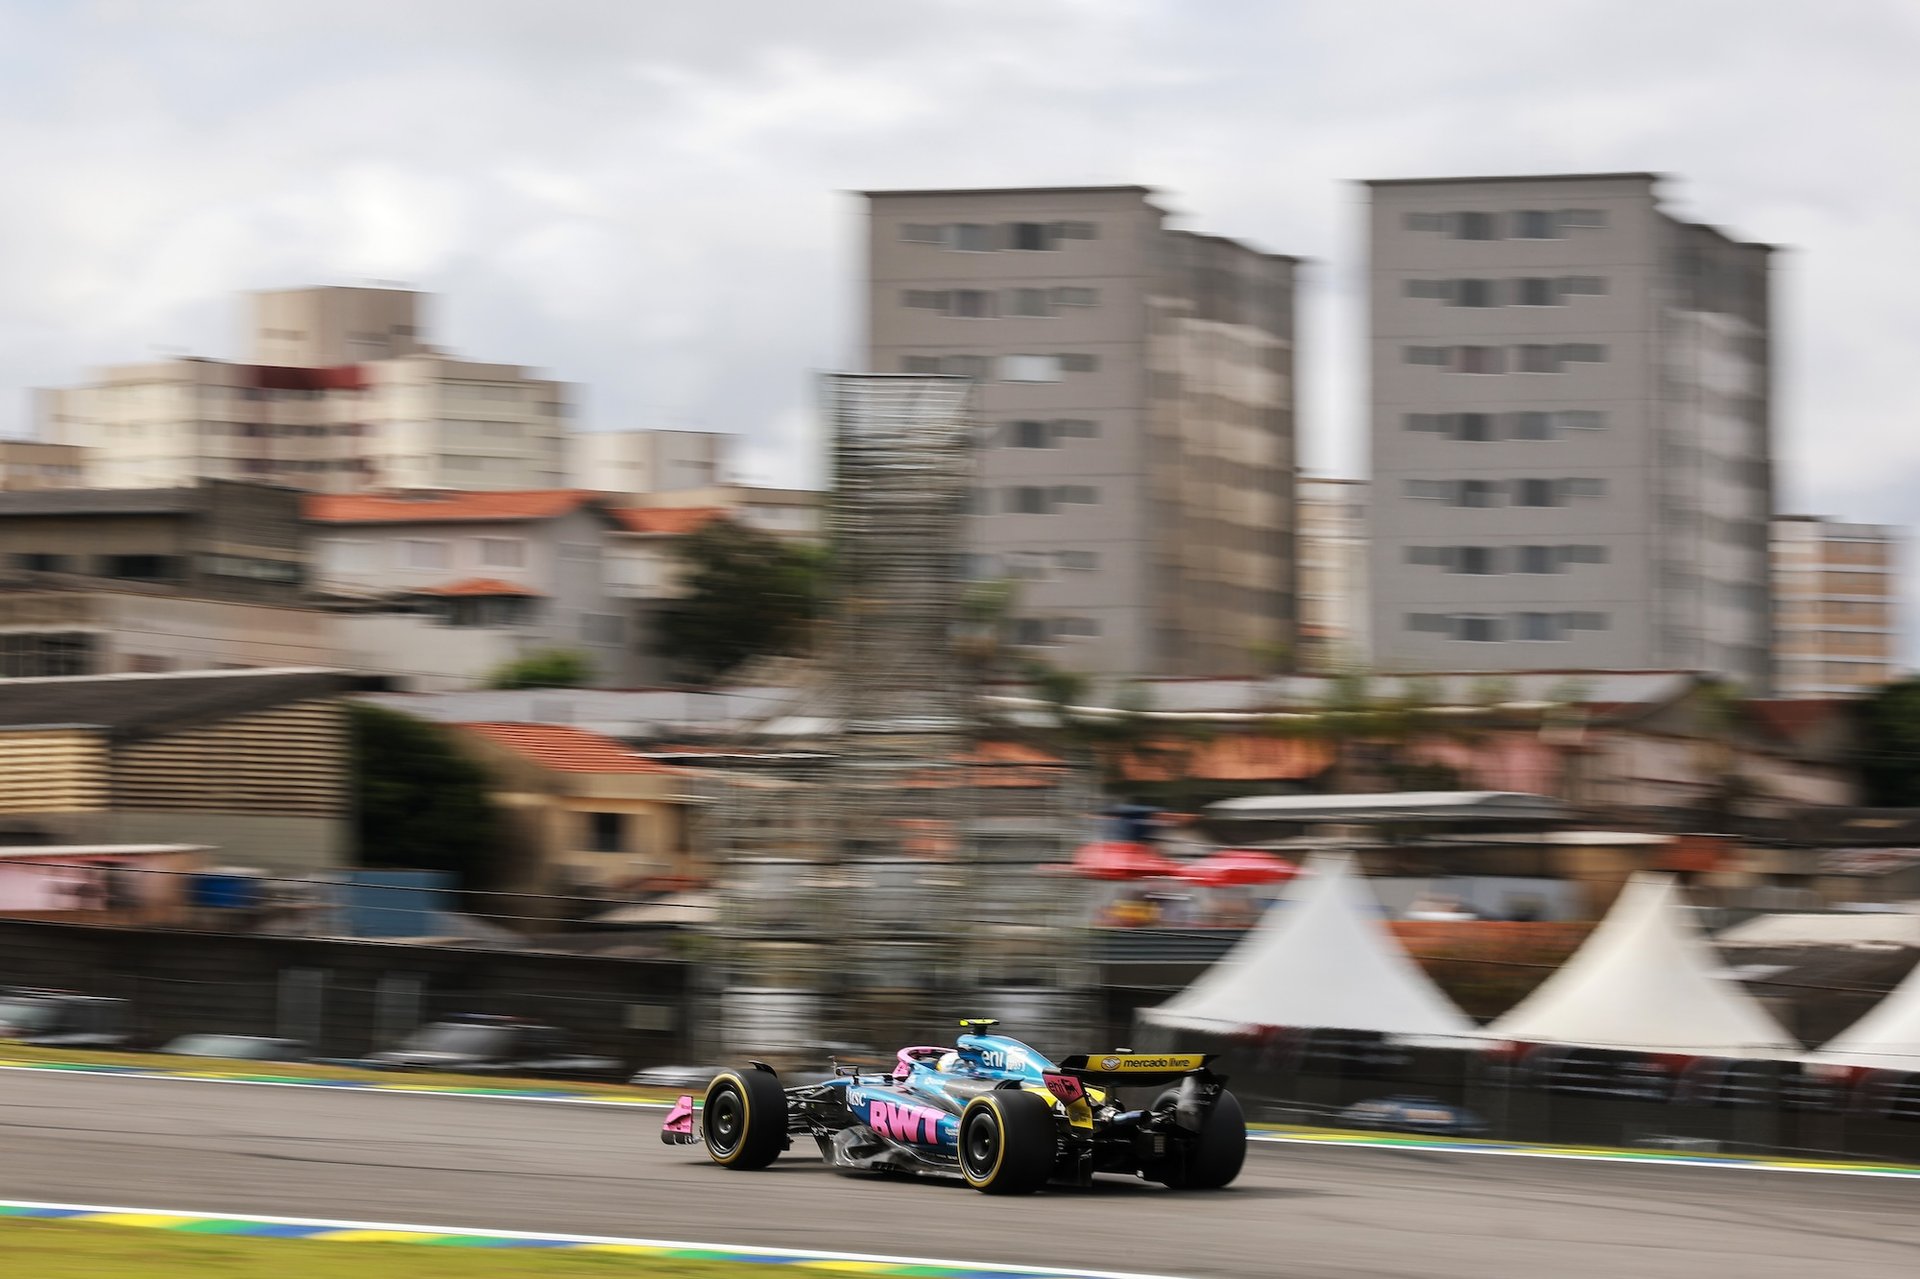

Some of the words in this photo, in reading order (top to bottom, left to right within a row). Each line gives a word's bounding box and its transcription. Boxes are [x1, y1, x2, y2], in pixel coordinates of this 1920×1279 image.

[981, 1050, 1004, 1067] eni
[1123, 1057, 1168, 1068] mercado
[1168, 1057, 1190, 1068] livre
[1047, 1079, 1064, 1096] eni
[870, 1100, 946, 1145] BWT
